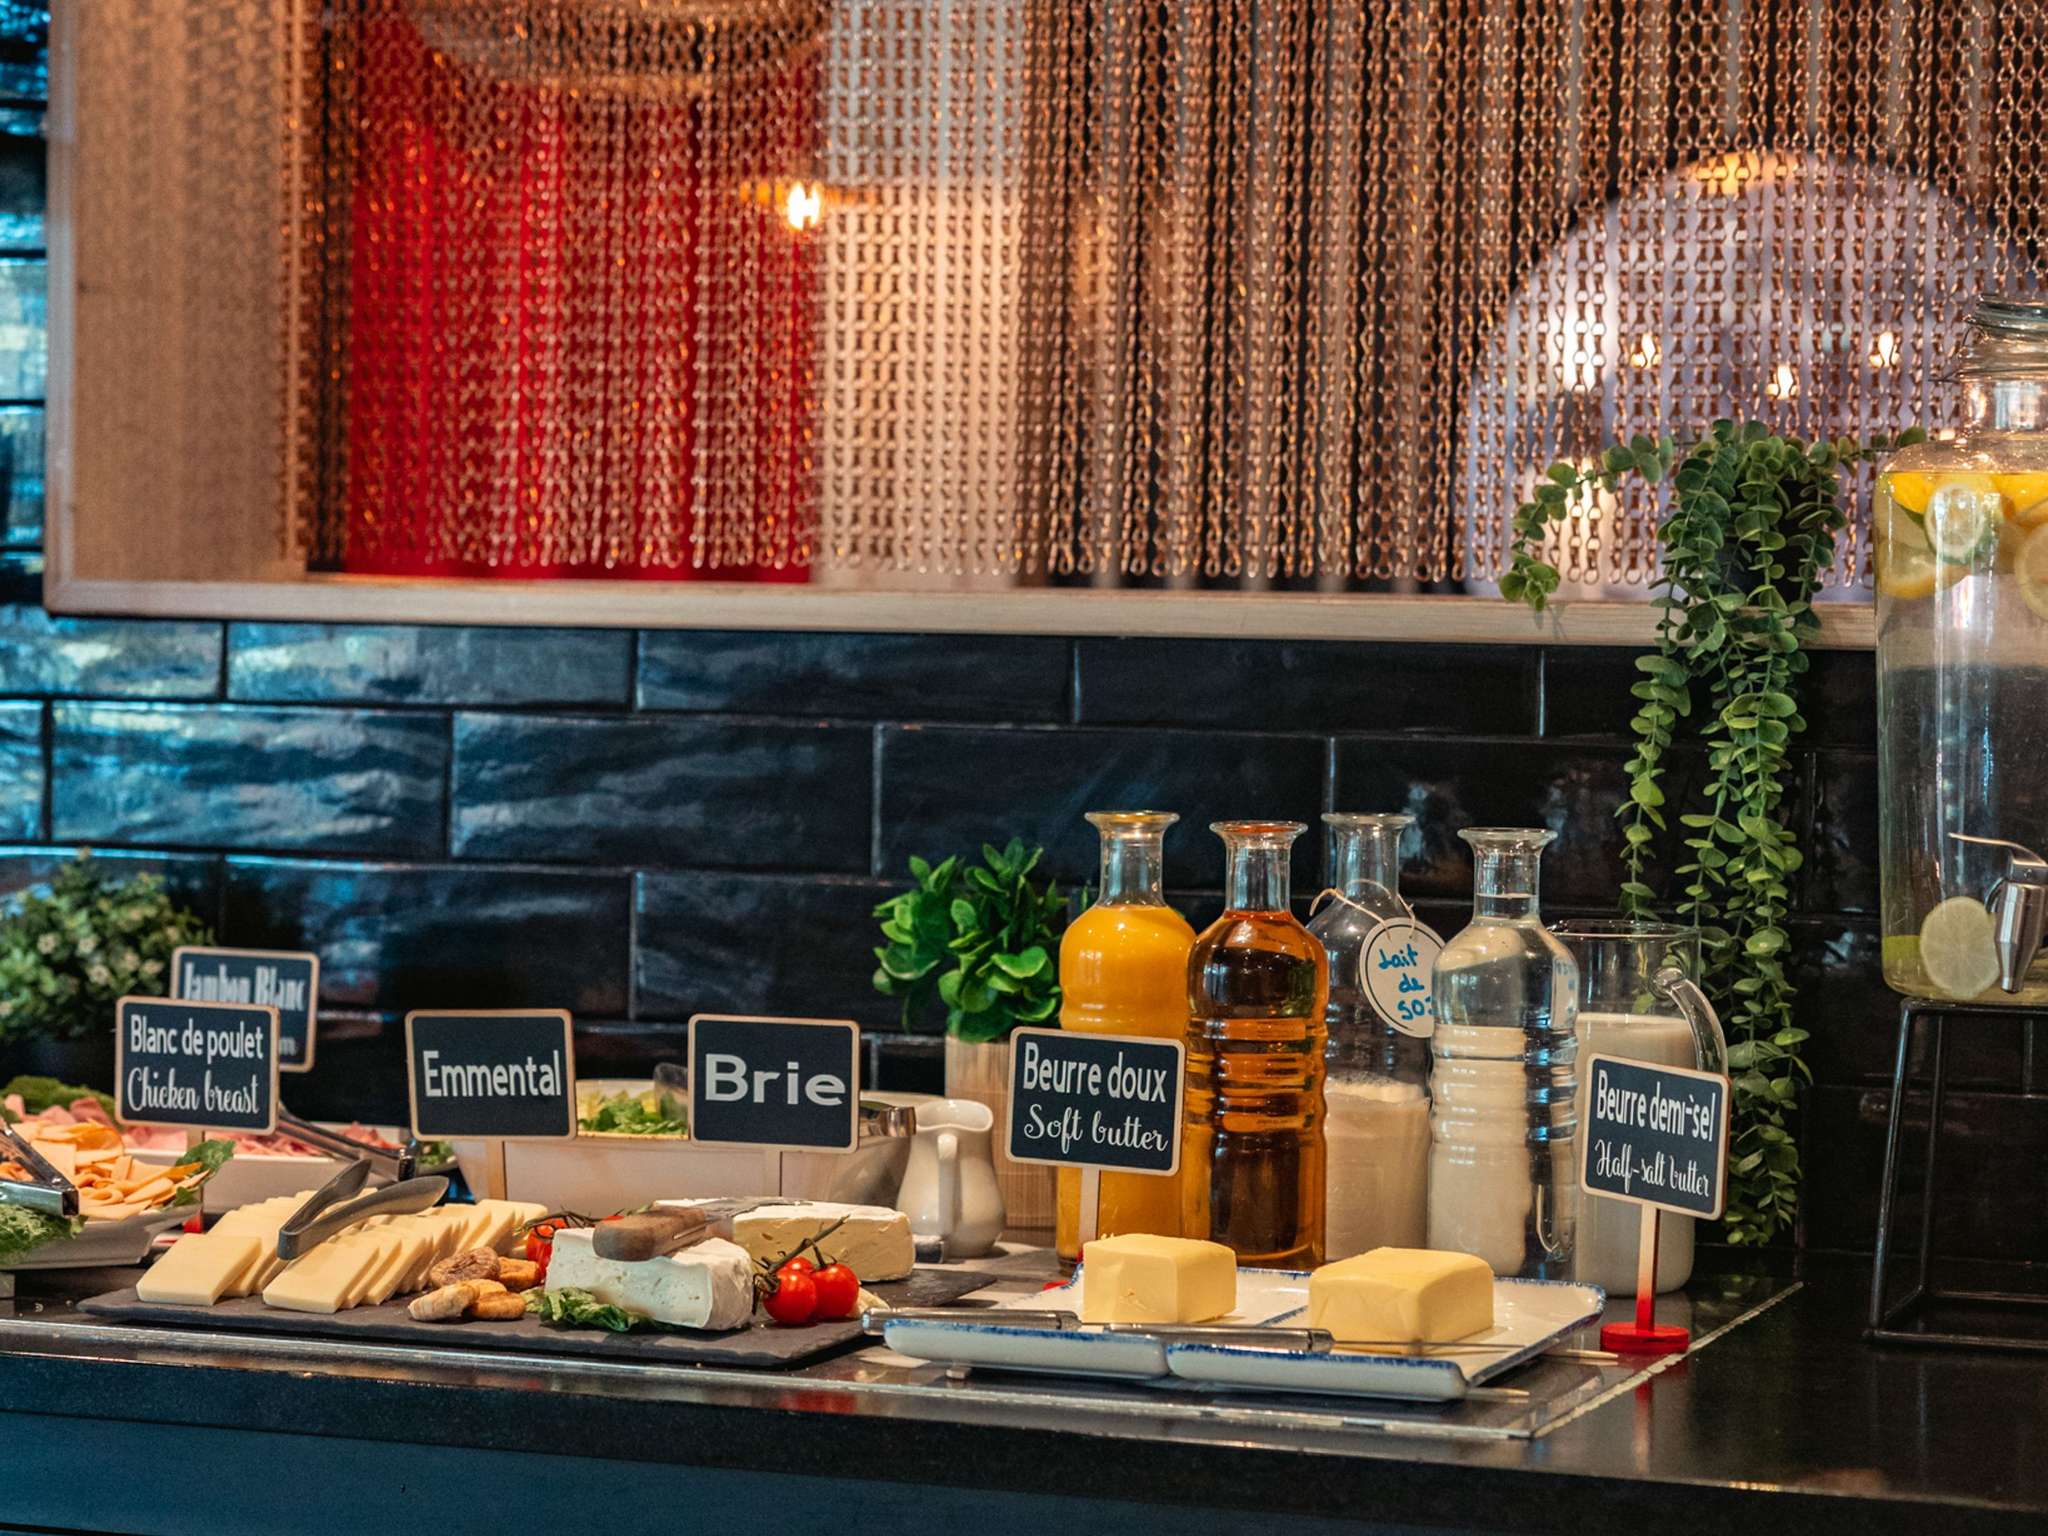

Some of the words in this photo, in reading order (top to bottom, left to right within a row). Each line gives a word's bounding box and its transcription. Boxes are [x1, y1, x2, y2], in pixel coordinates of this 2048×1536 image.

[1398, 972, 1425, 993] de
[130, 1014, 178, 1054] Blanc
[181, 1017, 204, 1056] de
[206, 1020, 264, 1065] poulet
[127, 1066, 200, 1112] Chicken
[204, 1069, 260, 1114] breast
[422, 1049, 562, 1097] Emmental
[705, 1053, 846, 1106] Brie
[1023, 1042, 1102, 1096] Beurre
[1107, 1051, 1168, 1103] doux
[1596, 1069, 1647, 1128] Beurre
[1023, 1103, 1084, 1154] Soft
[1092, 1110, 1169, 1151] butter
[1594, 1139, 1666, 1194] Half-salt
[1669, 1155, 1710, 1197] butter
